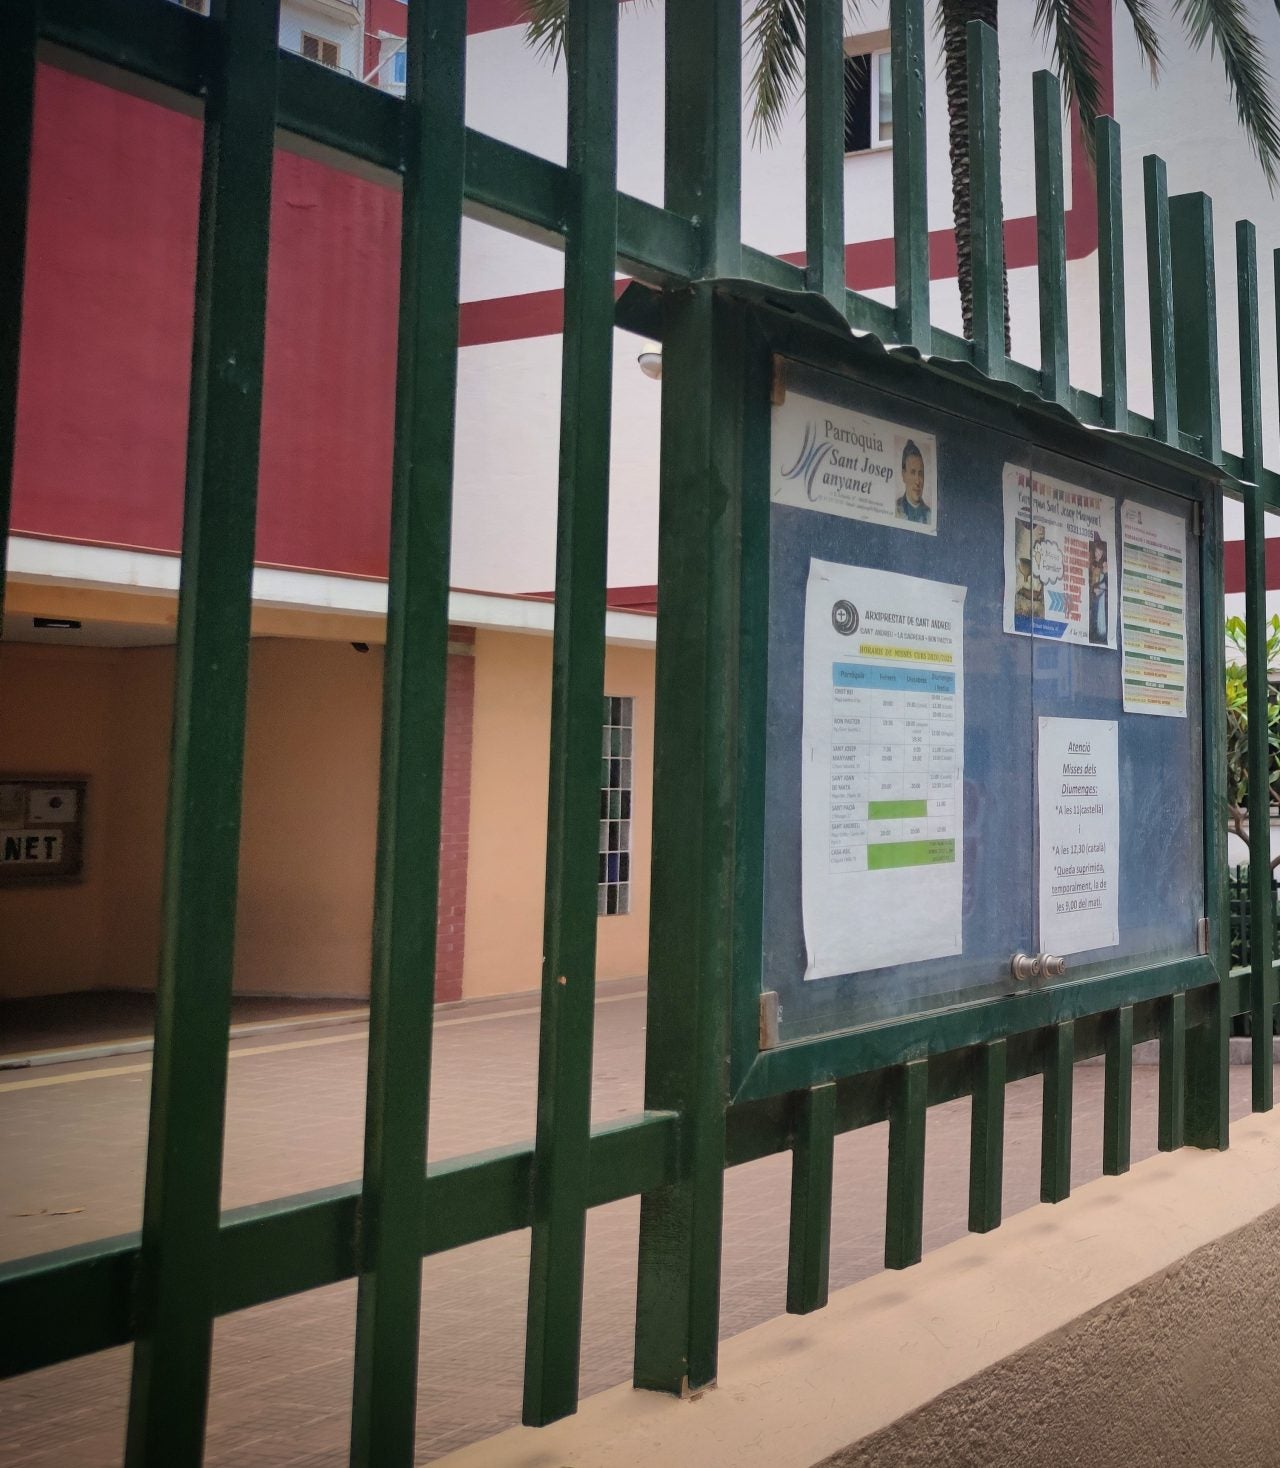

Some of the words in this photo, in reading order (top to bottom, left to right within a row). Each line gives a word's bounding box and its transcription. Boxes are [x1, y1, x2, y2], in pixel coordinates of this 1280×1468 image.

[824, 419, 884, 454] Parròquia
[829, 448, 859, 472] Sant
[861, 457, 894, 483] Josep
[864, 610, 905, 625] ARXIPRESTAT
[907, 616, 914, 625] DE
[915, 617, 929, 627] SANT
[931, 619, 952, 631] ANDREU
[1067, 741, 1091, 753] Atenció
[1062, 763, 1083, 775] Misses
[1084, 763, 1097, 774] dels
[1061, 783, 1098, 796] Diumenges:
[1064, 805, 1073, 815] les
[0, 836, 57, 861] NET
[1061, 845, 1069, 855] les
[1051, 881, 1093, 895] temporalment,
[1093, 880, 1099, 889] la
[1099, 878, 1107, 889] de
[1056, 901, 1065, 912] les
[1078, 898, 1087, 909] del
